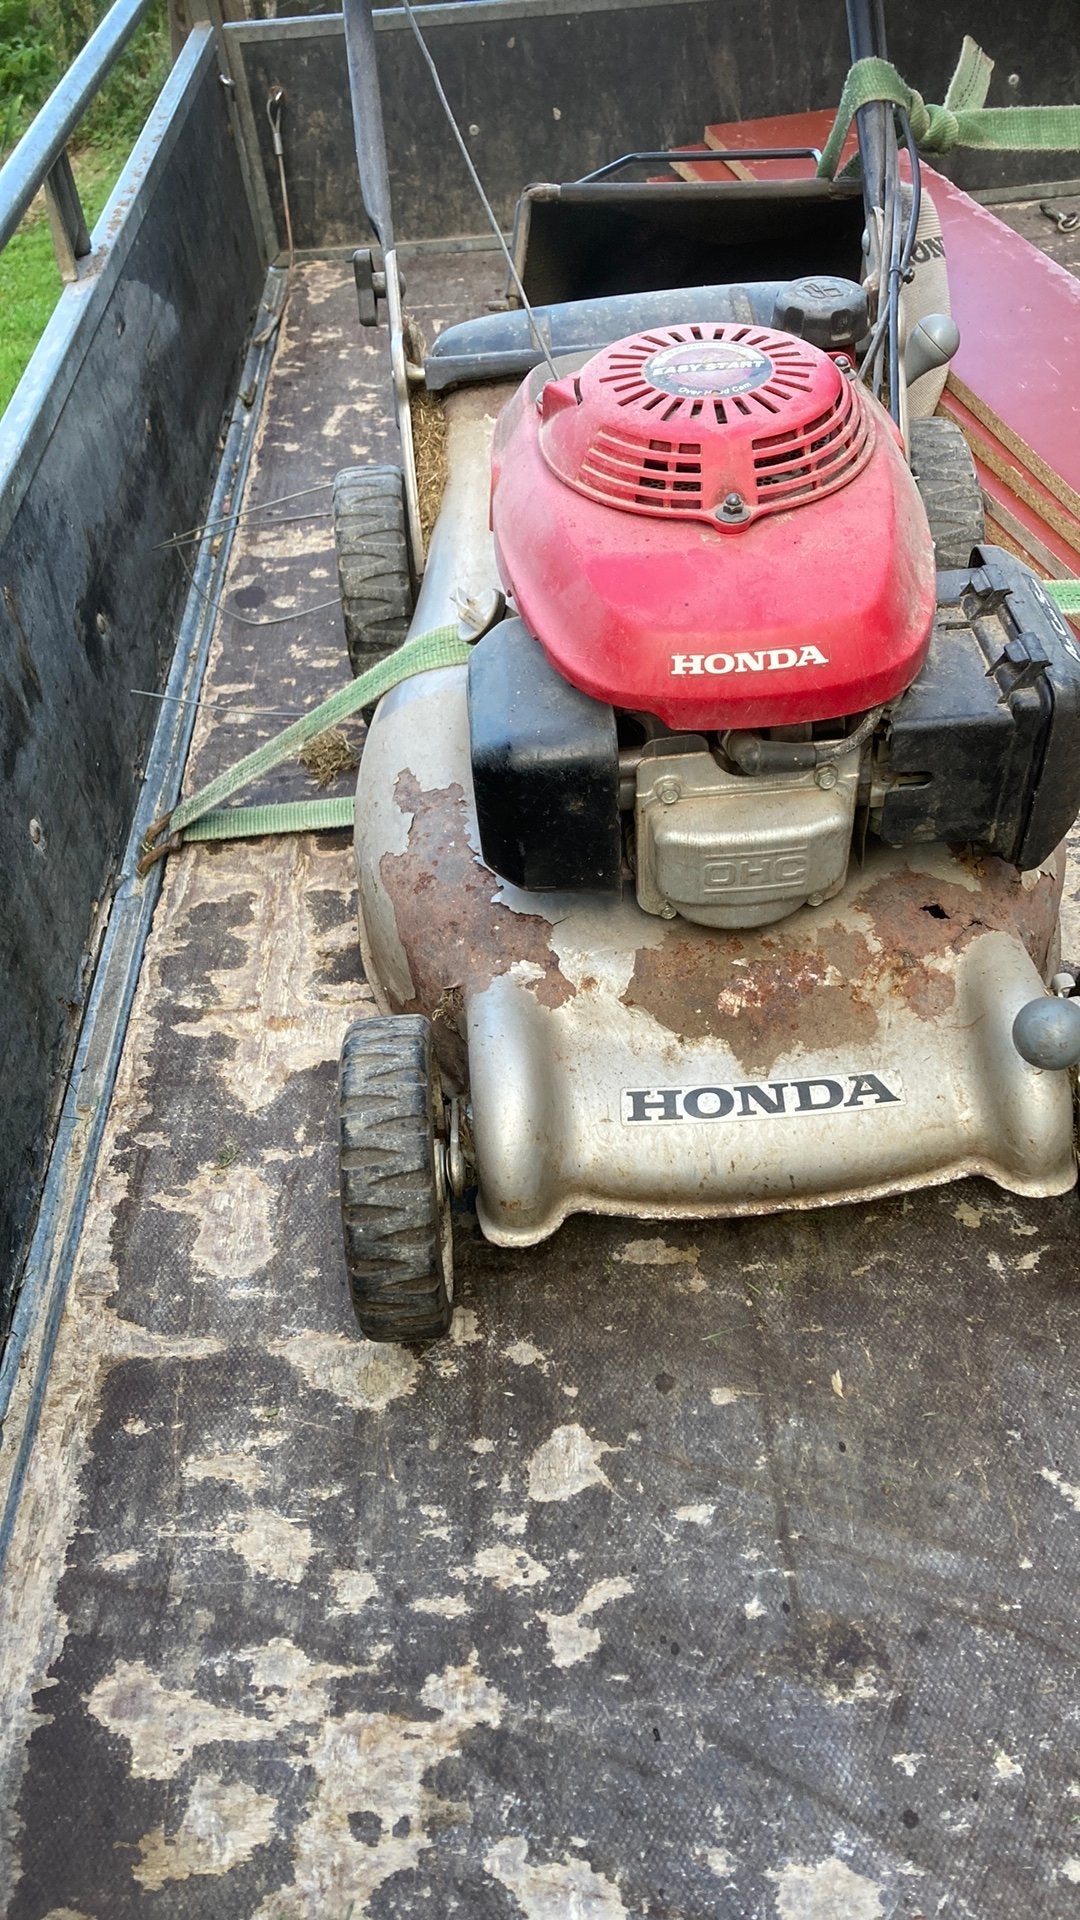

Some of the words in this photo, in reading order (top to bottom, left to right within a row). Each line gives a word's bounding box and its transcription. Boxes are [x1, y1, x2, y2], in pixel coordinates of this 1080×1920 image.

[653, 362, 702, 376] EASY
[705, 359, 765, 372] START
[678, 387, 703, 396] Over
[731, 382, 752, 393] Cam
[671, 645, 829, 675] HONDA
[703, 855, 805, 887] OHC
[626, 1073, 902, 1122] HONDA
